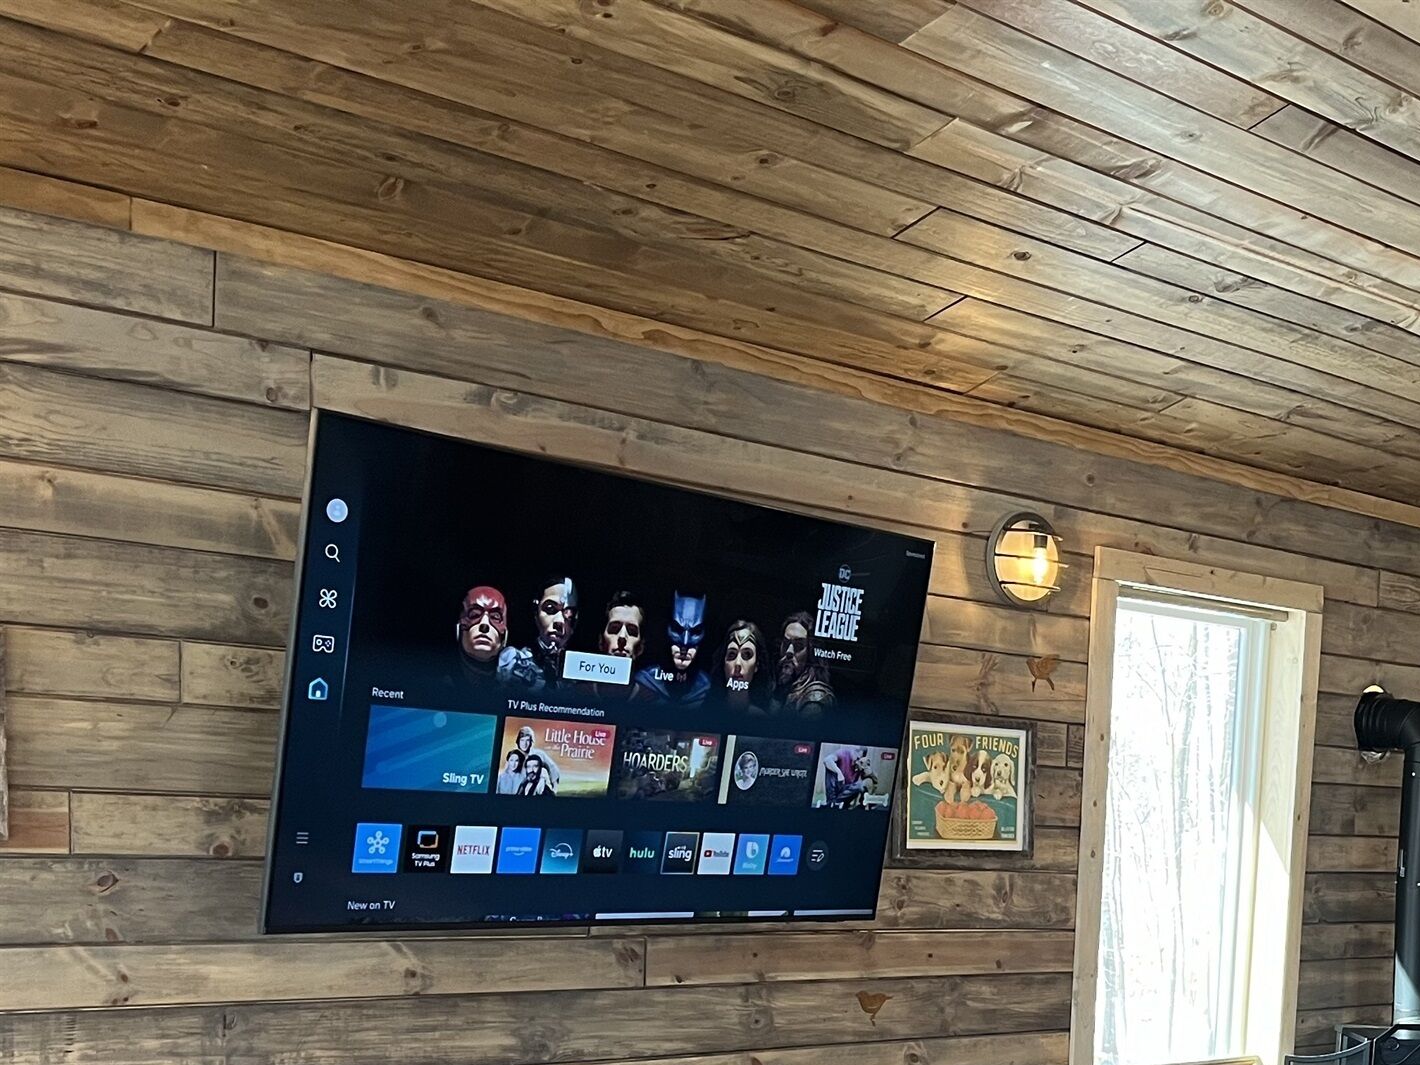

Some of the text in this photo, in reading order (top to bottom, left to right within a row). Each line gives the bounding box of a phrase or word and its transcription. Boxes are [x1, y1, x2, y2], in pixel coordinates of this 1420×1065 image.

[817, 582, 865, 616] JUSTICE
[814, 609, 861, 642] LEAGUE
[814, 647, 852, 661] Watch Free
[579, 661, 616, 675] For You
[654, 668, 674, 681] Live
[726, 677, 749, 691] Apps
[372, 686, 404, 699] Recent
[508, 699, 605, 717] TV Plus Recommendation
[545, 727, 571, 743] Little
[560, 743, 595, 759] Prairie
[914, 733, 1019, 759] FOUR FRIENDS
[623, 751, 689, 773] HOARDERS
[442, 772, 485, 787] Sling TV
[411, 852, 440, 861] Samsung
[457, 844, 491, 856] NETFLIX
[629, 847, 656, 859] hulu
[667, 848, 693, 862] sling
[347, 900, 396, 911] New on TV
